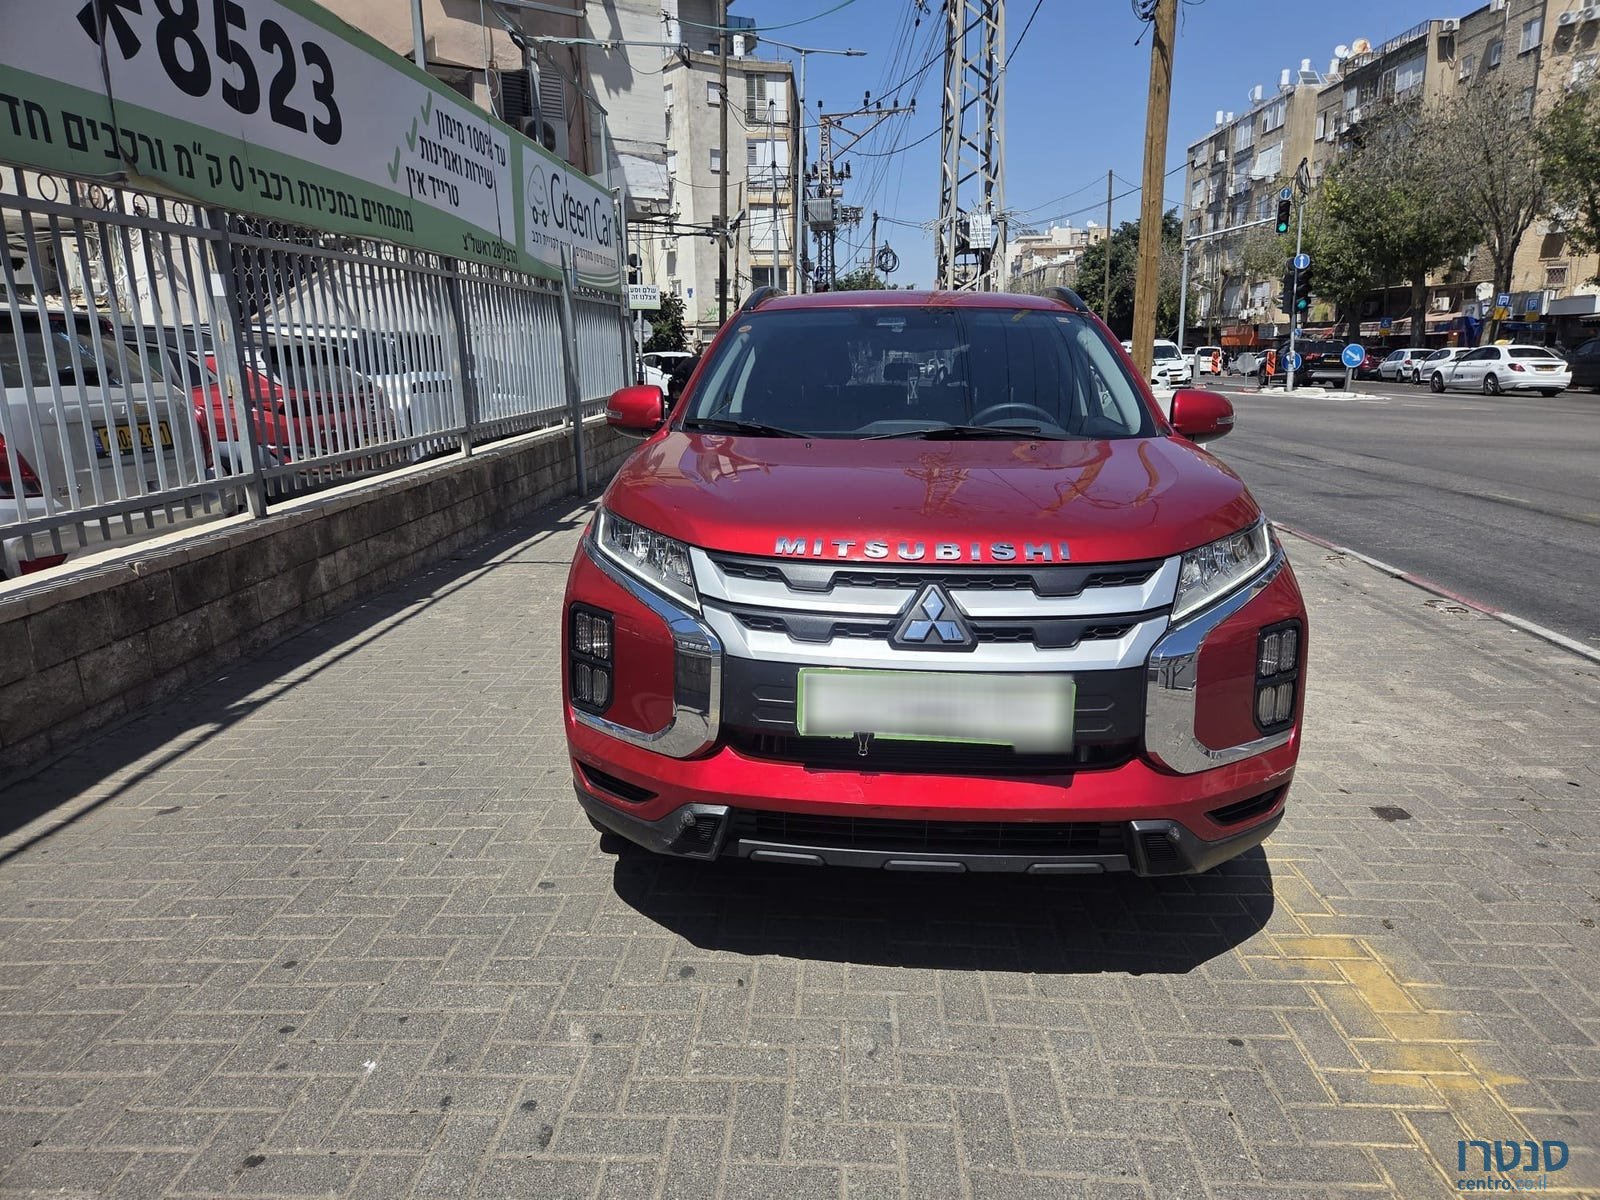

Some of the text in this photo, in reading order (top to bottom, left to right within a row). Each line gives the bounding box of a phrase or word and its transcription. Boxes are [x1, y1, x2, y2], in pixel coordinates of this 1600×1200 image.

[436, 109, 465, 145] מימון
[229, 155, 244, 192] 0
[420, 136, 493, 189] שירות ואמינות
[494, 143, 506, 167] עד
[248, 166, 294, 204] רכבי
[298, 180, 359, 220] במכירת
[406, 166, 459, 207] טרייד אין
[361, 198, 414, 233] מתמחים
[551, 173, 611, 248] Green Car
[775, 536, 1071, 562] MITSUBISHI
